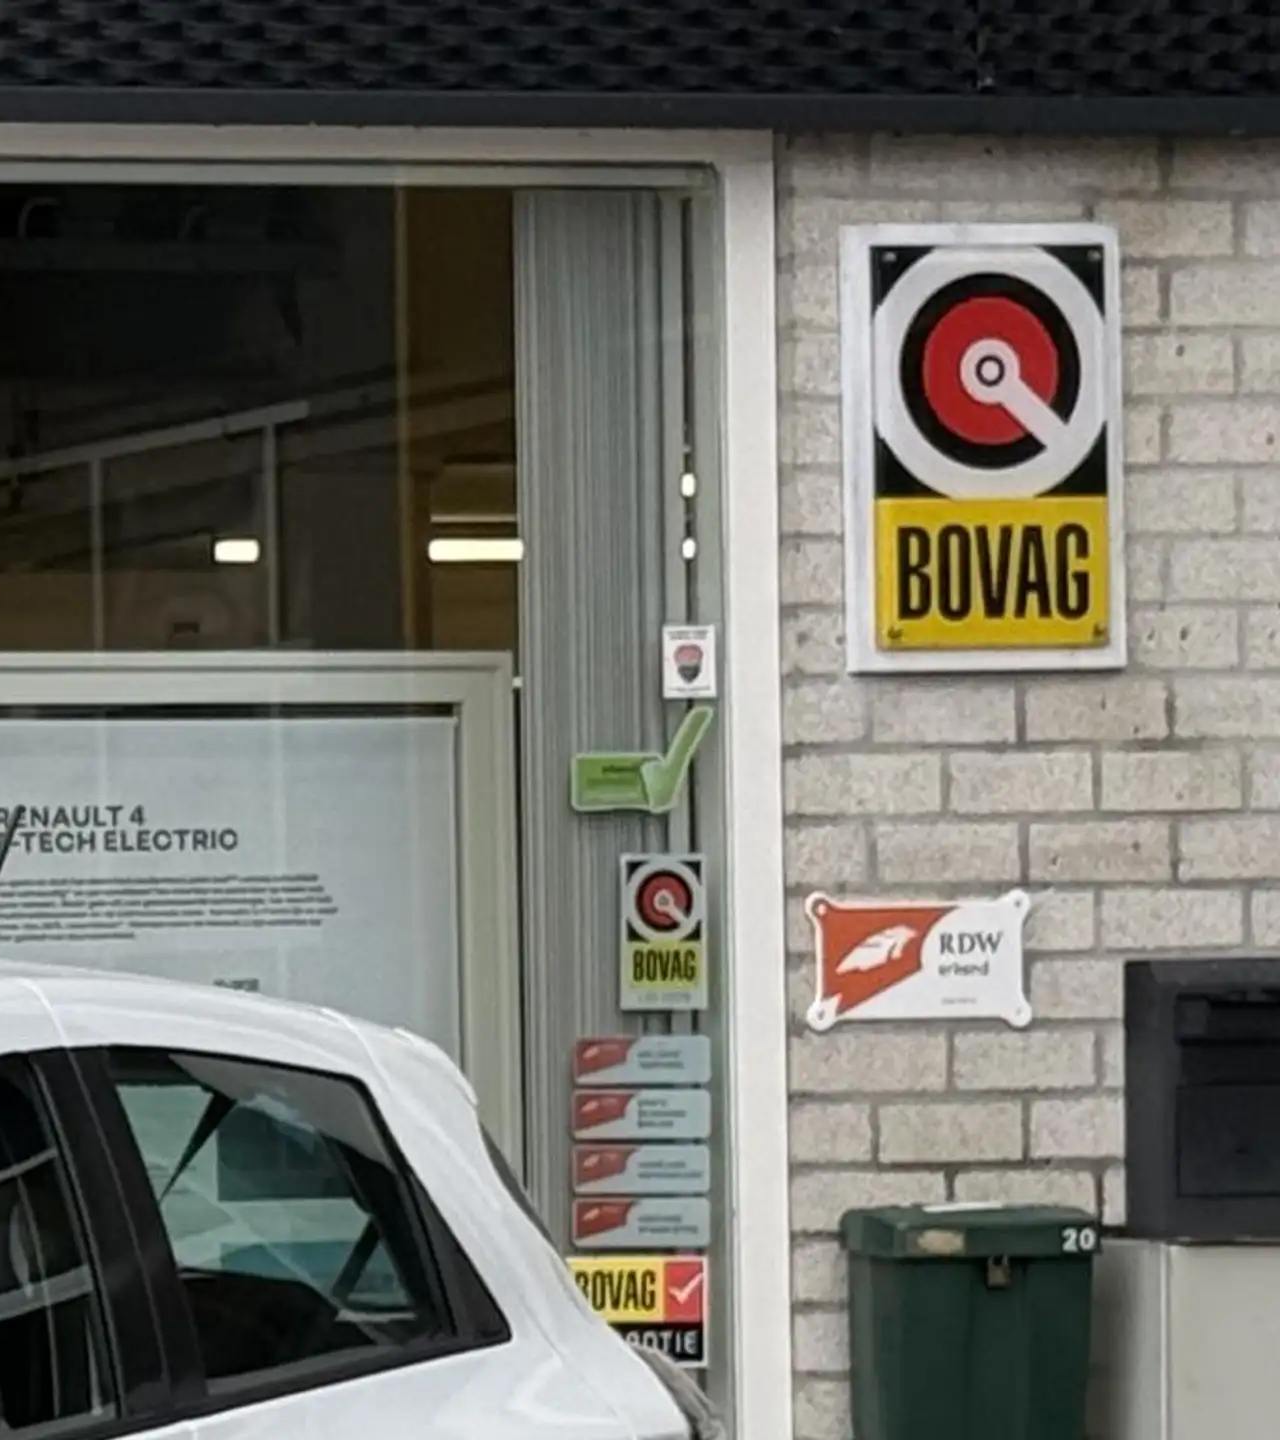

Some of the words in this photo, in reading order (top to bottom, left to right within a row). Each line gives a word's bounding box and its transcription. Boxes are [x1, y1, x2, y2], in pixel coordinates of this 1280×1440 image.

[897, 523, 1090, 621] BOVAG
[129, 804, 146, 827] 4
[103, 828, 238, 853] ELECTRIC
[940, 931, 1003, 956] RDW
[633, 949, 696, 983] BOVAG
[1062, 1228, 1096, 1252] 20
[575, 1270, 657, 1312] BOVAG
